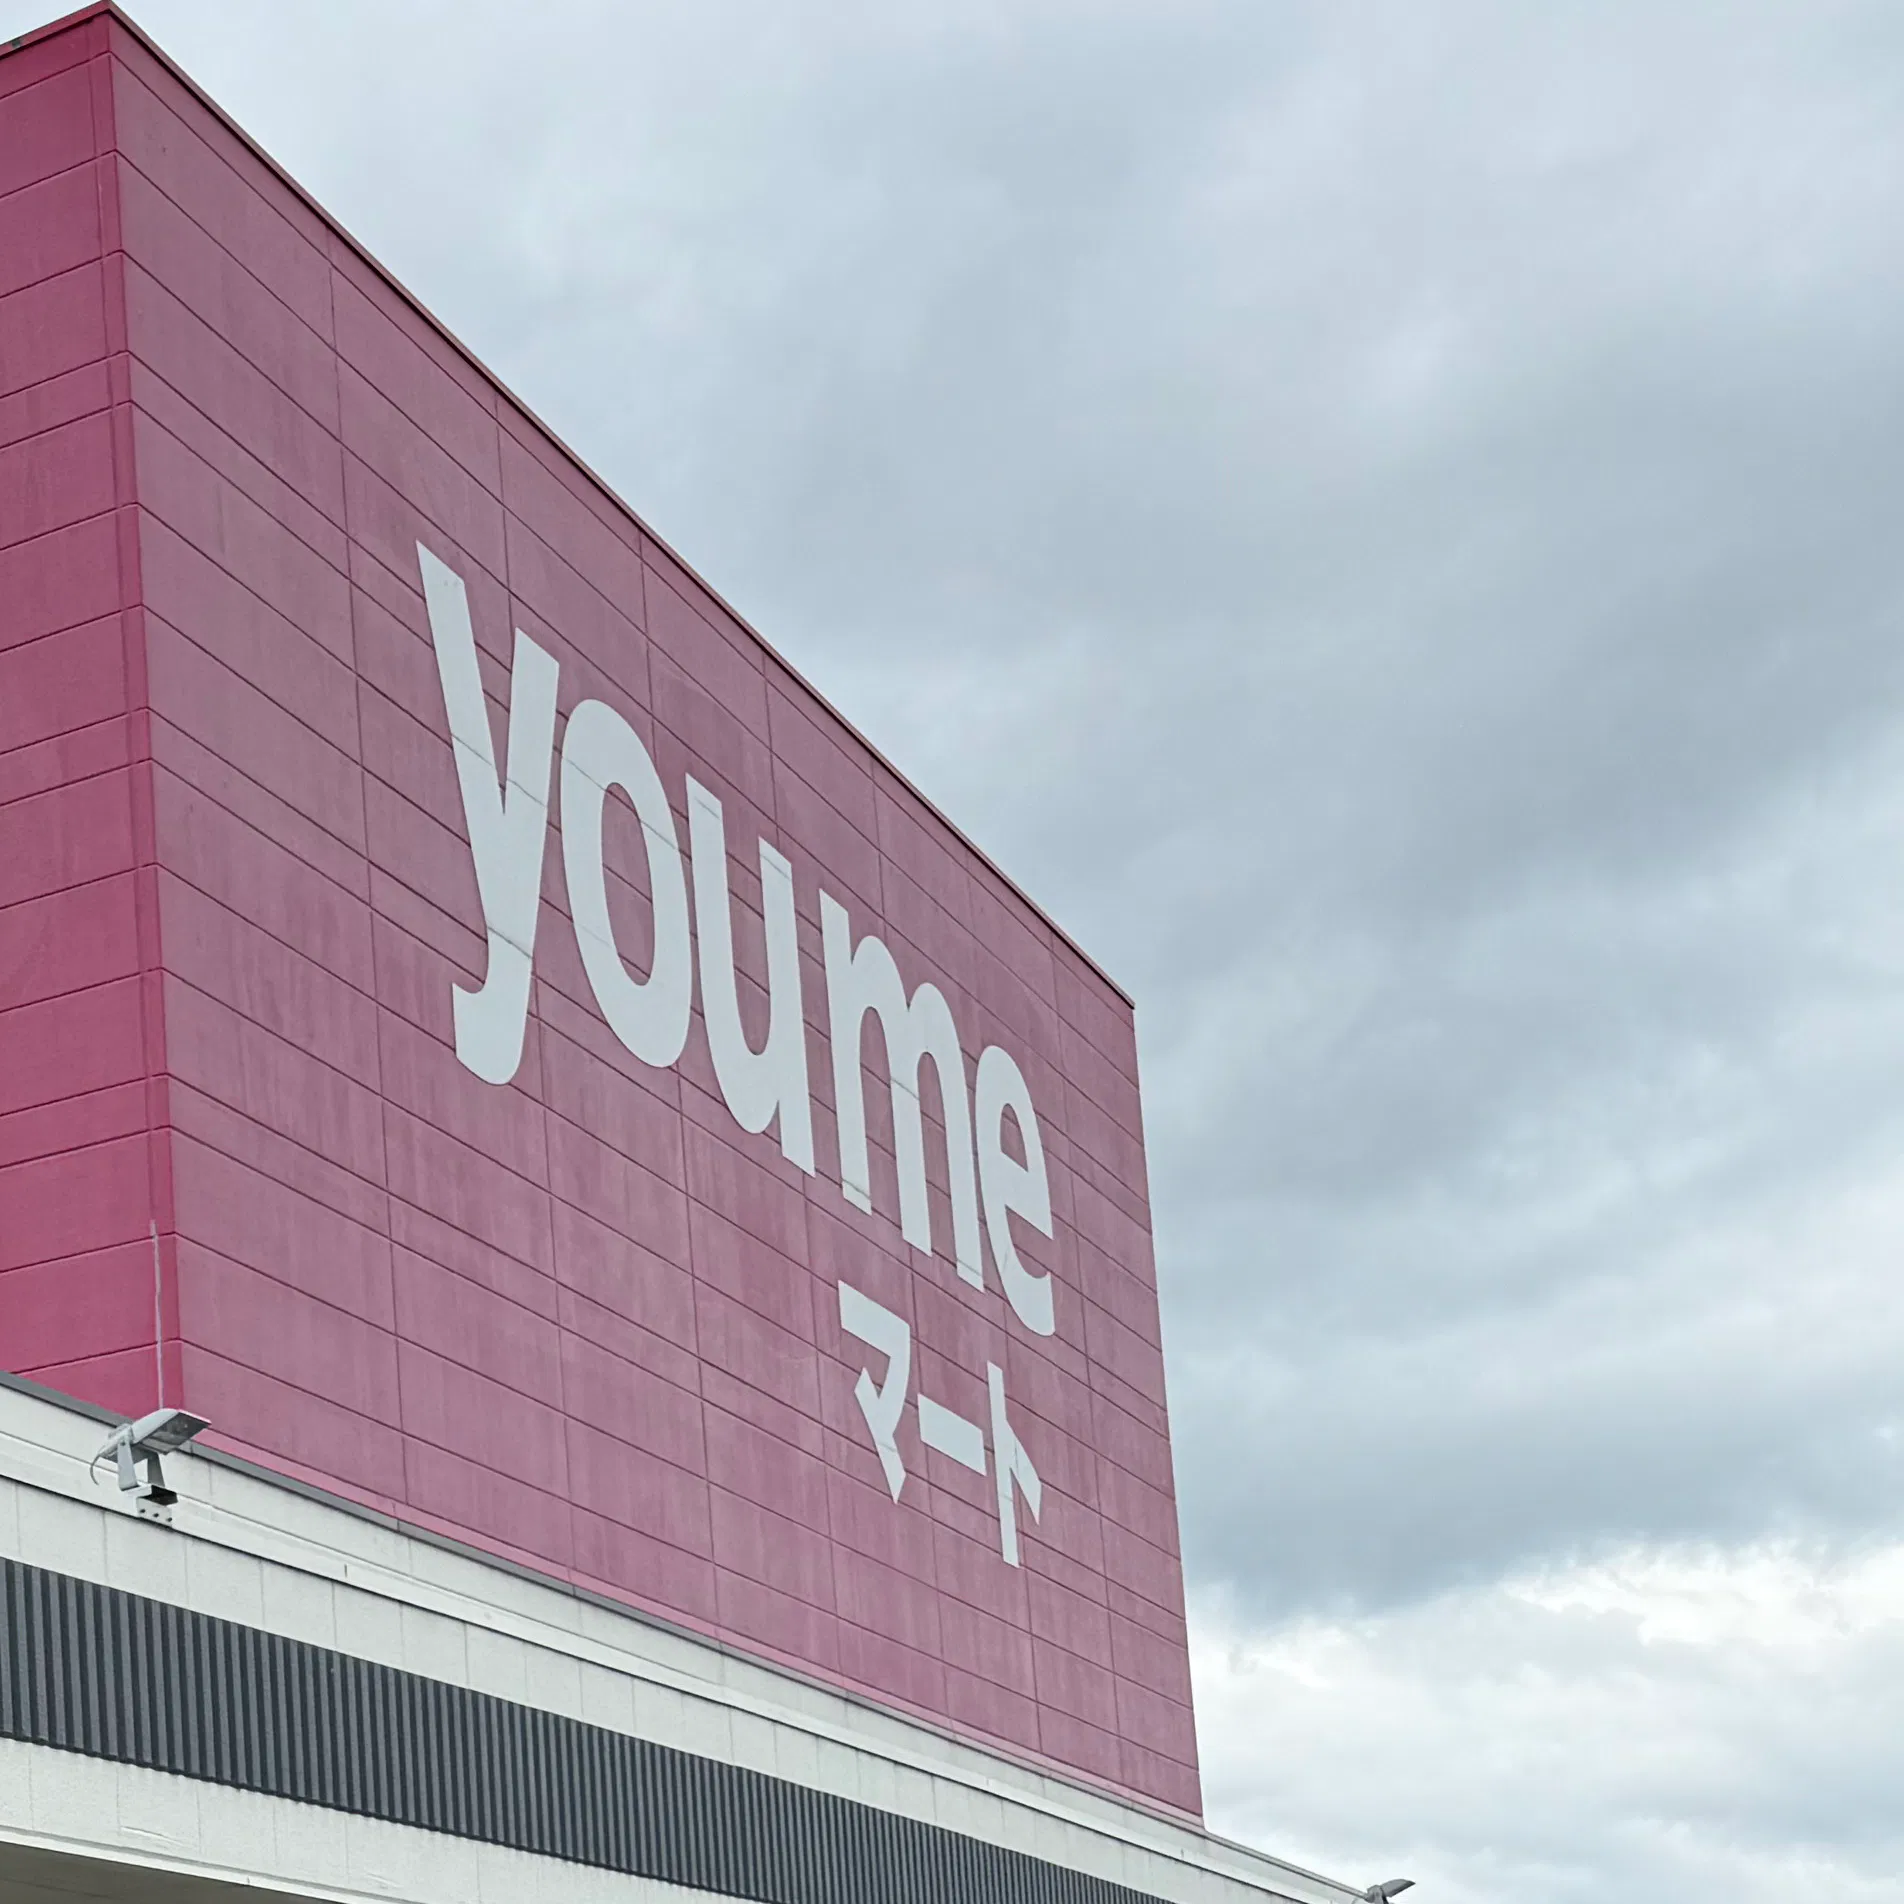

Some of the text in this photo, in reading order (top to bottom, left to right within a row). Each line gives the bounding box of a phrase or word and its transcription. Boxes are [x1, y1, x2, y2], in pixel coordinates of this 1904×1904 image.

[415, 539, 1056, 1337] youme
[838, 1278, 1043, 1568] マート
